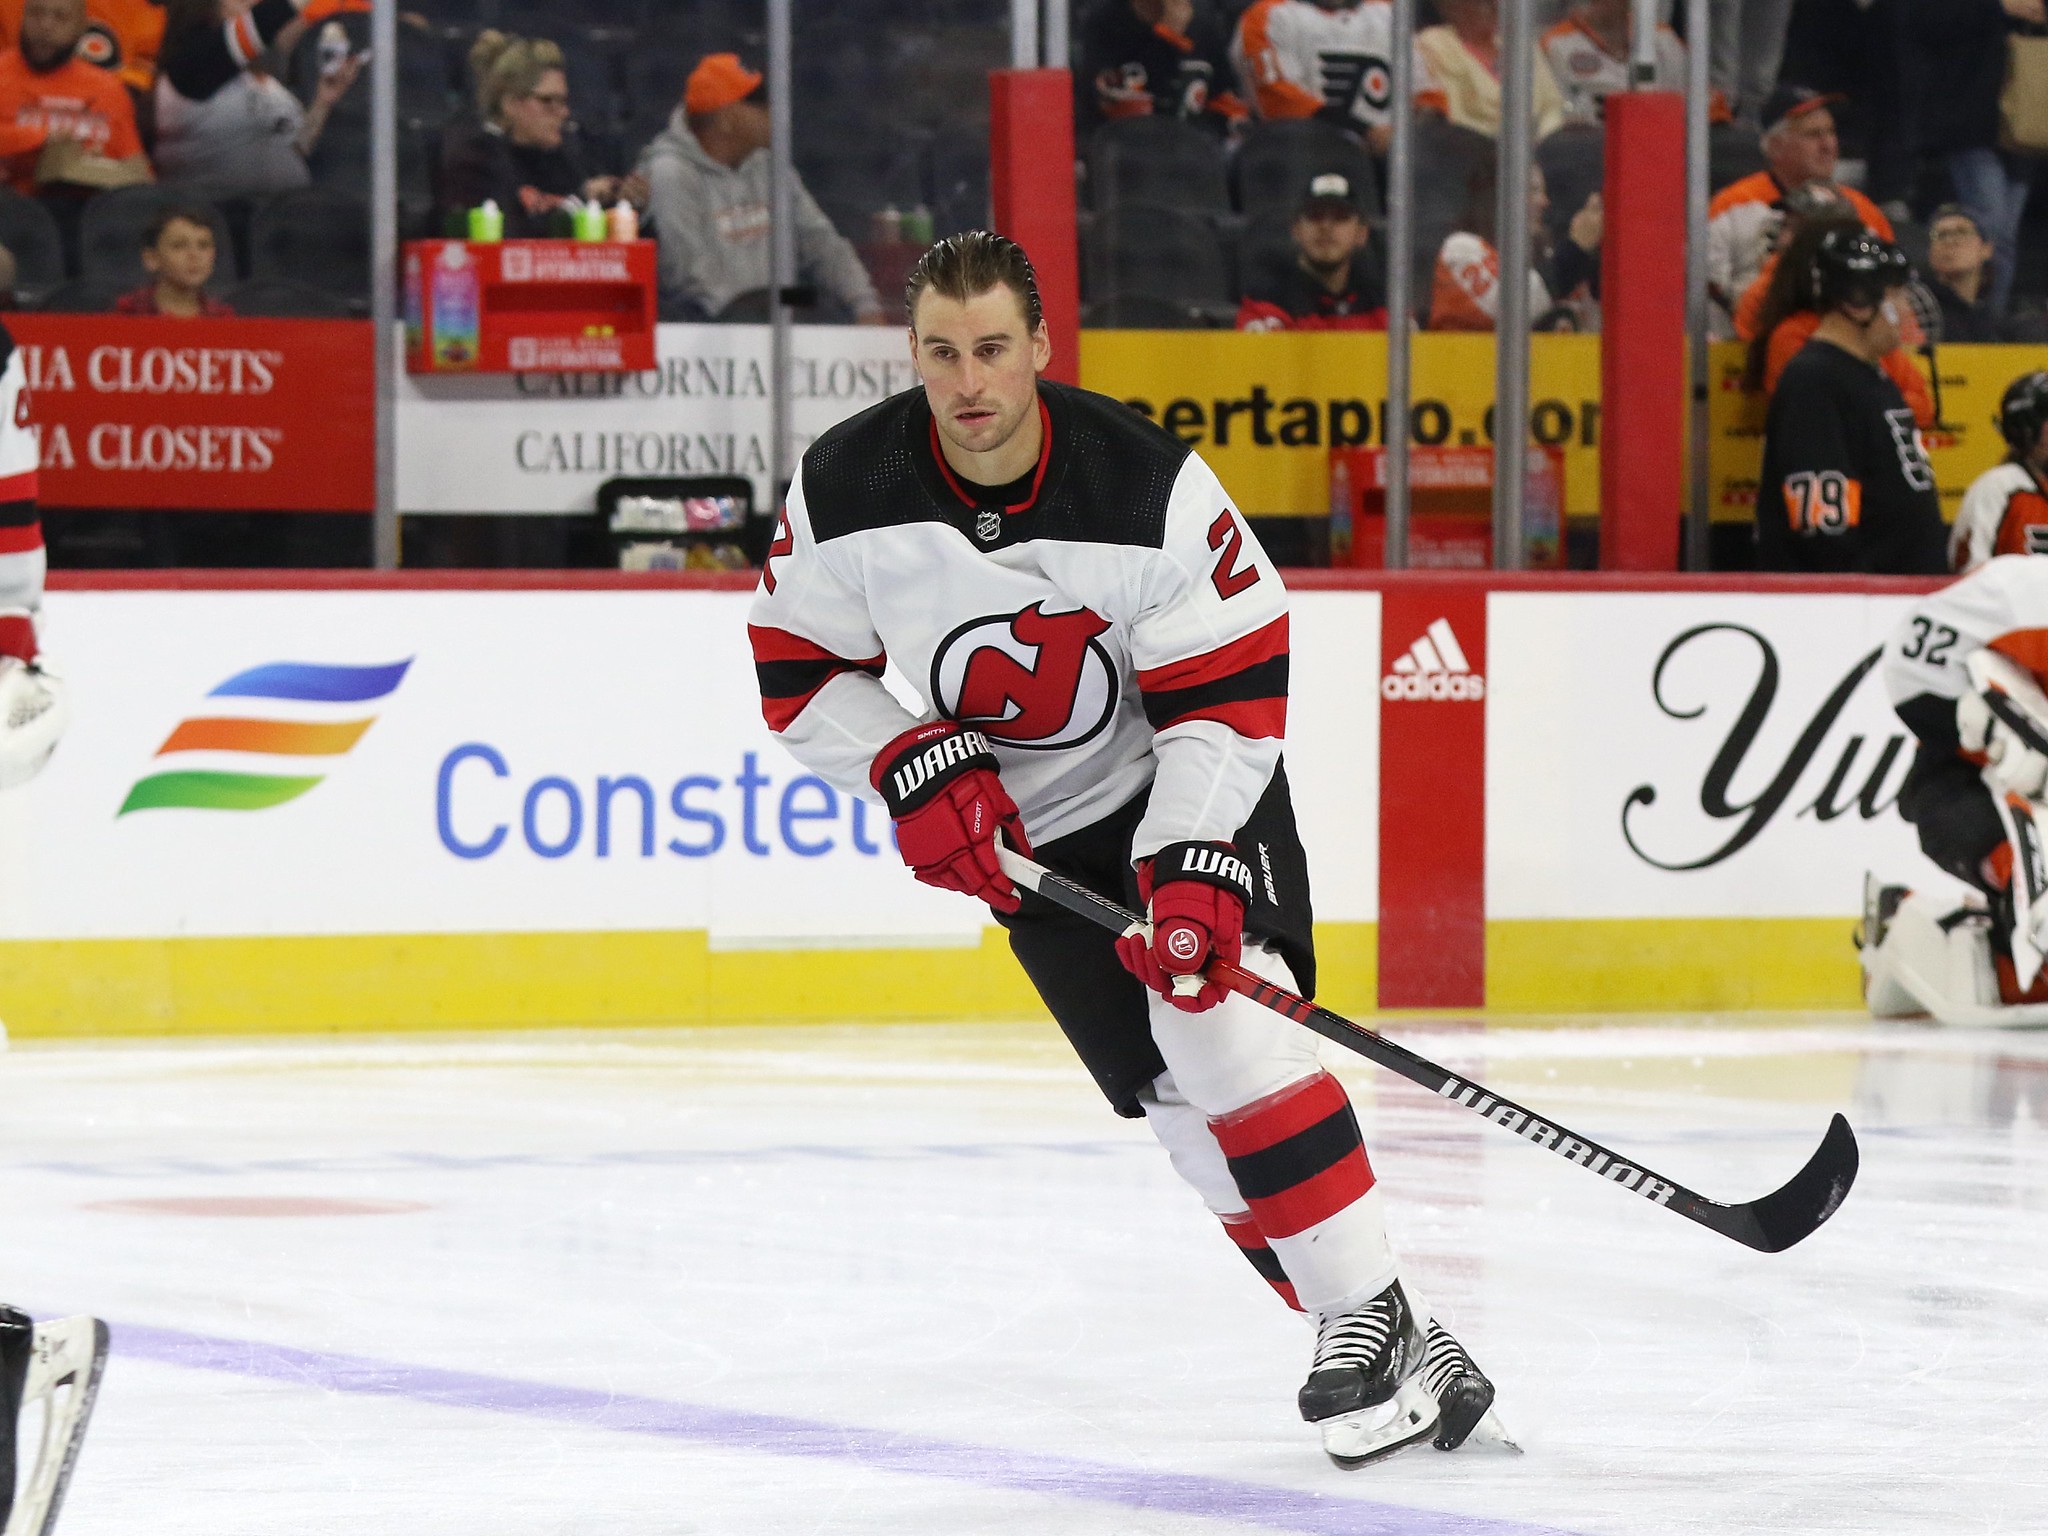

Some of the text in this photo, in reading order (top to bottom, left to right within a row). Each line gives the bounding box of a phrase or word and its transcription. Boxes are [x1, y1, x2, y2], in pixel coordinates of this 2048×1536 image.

[87, 346, 275, 394] CLOSETS
[87, 423, 275, 472] CLOSETS
[515, 430, 768, 474] CALIFORNIA
[1784, 470, 1849, 536] 79
[1207, 508, 1261, 601] 2
[1902, 614, 1959, 667] 32
[1381, 674, 1484, 702] adidas
[917, 727, 946, 740] SMITH
[434, 741, 900, 859] Constel
[973, 800, 983, 834] COVERT
[1438, 1077, 1676, 1207] WARRIOR
